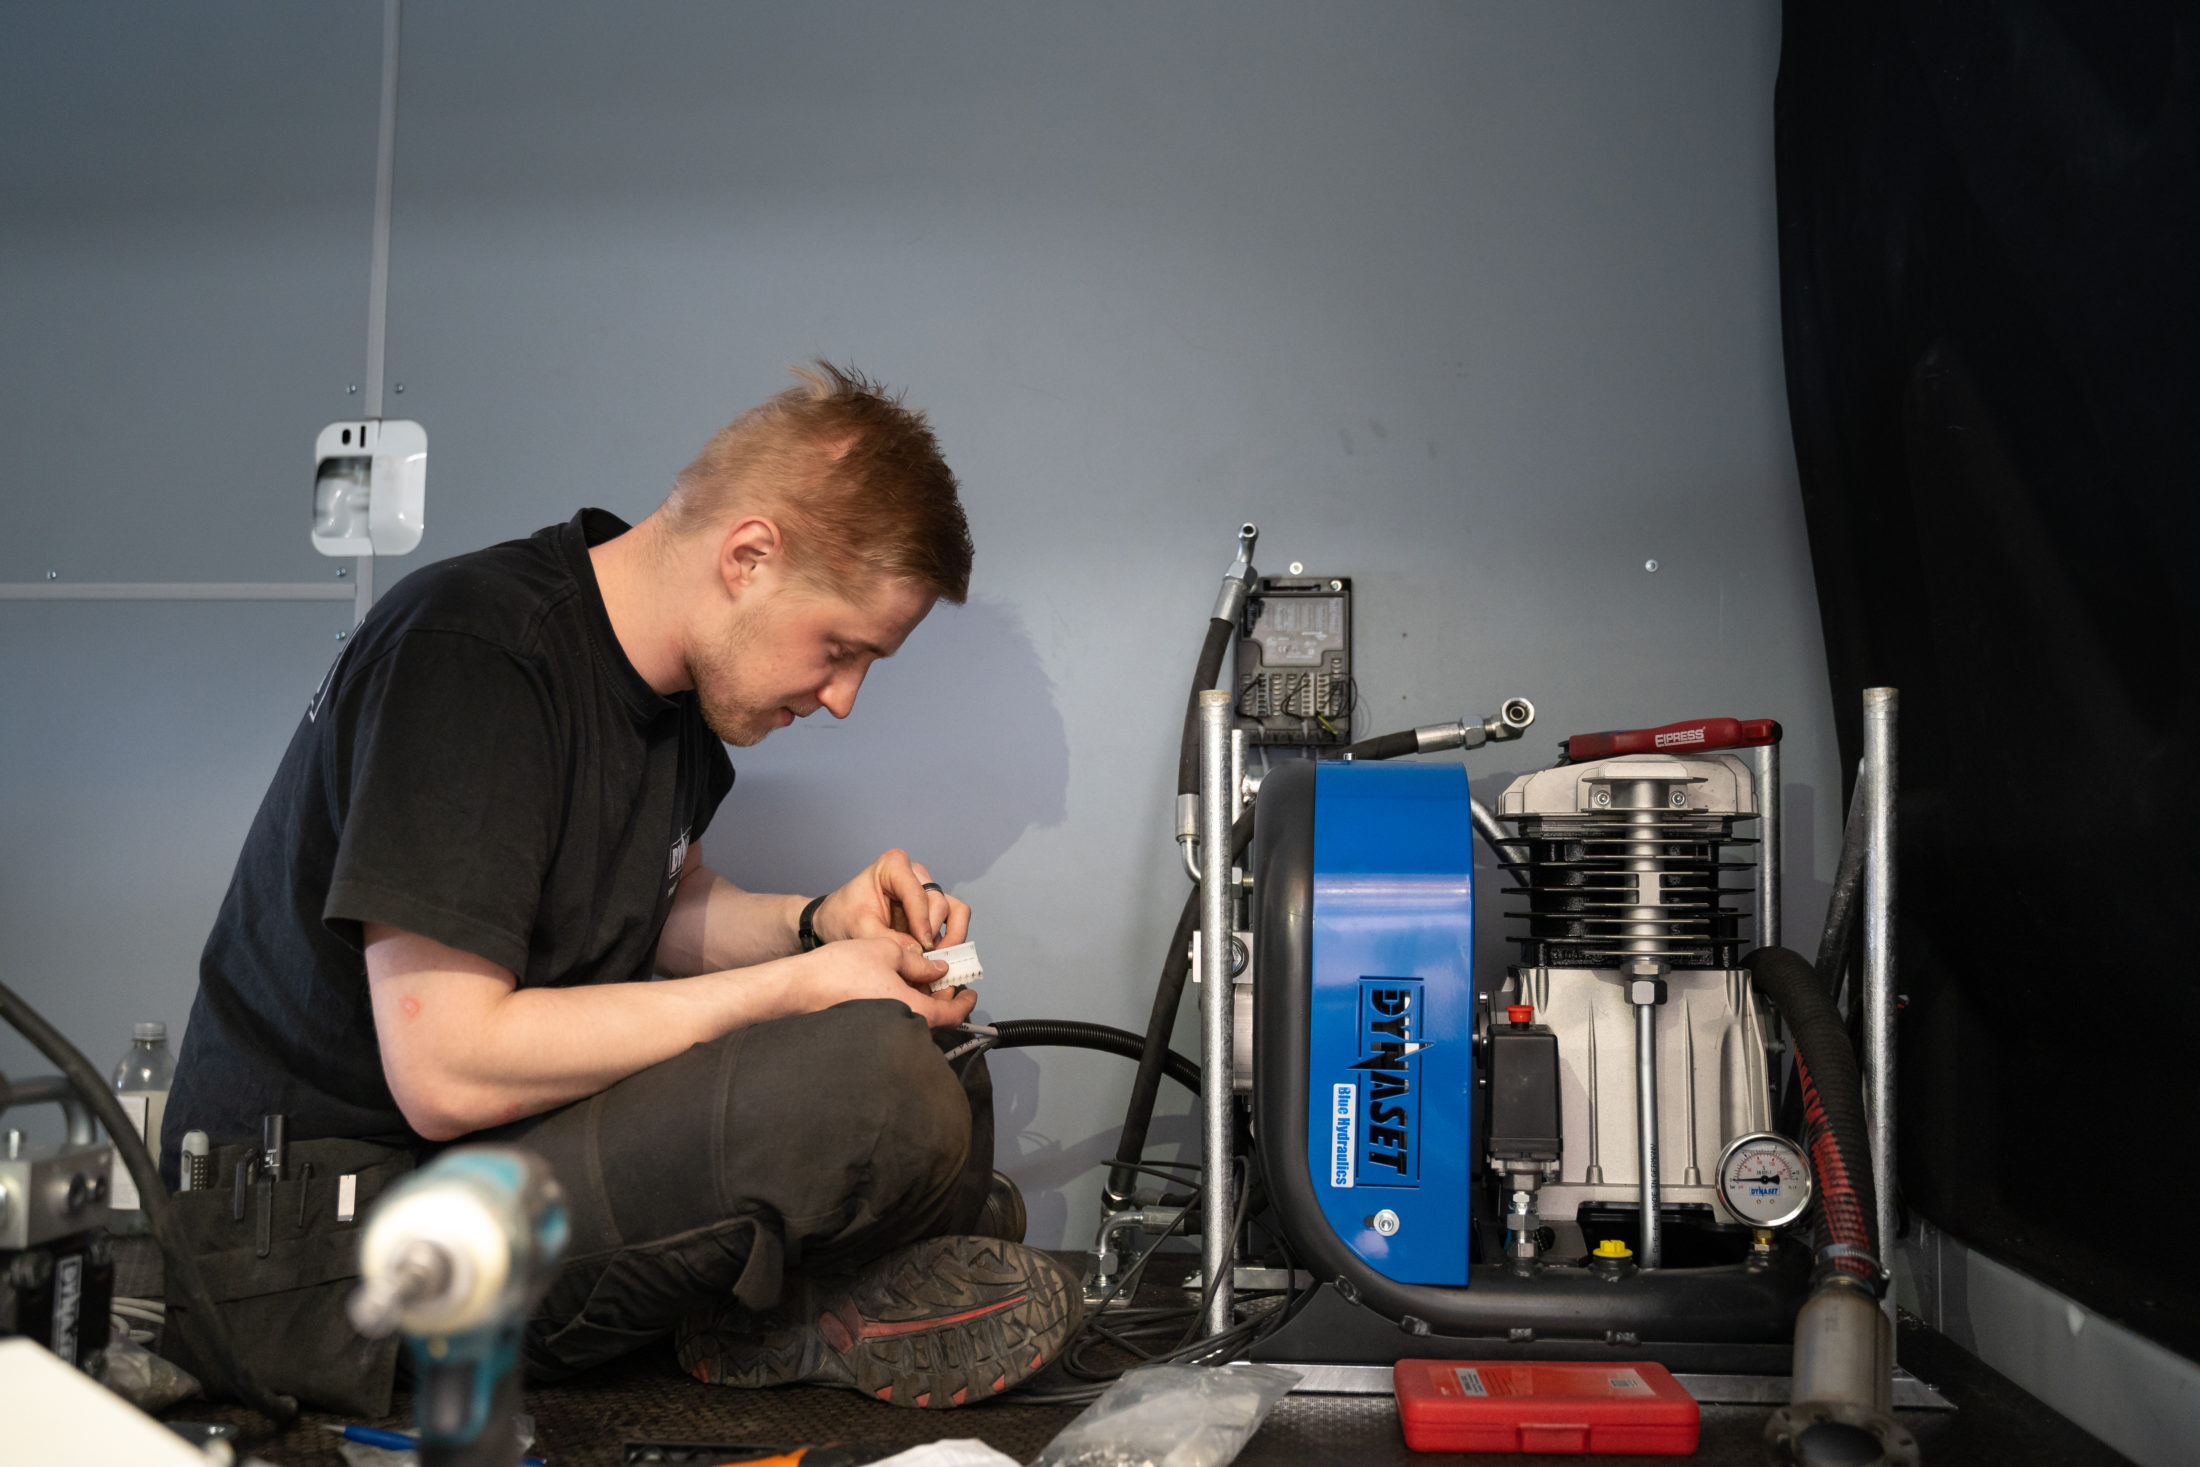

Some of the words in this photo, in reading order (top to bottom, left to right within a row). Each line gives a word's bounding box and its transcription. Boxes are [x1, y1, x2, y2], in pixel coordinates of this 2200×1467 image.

[1338, 1086, 1351, 1114] Blue
[1350, 989, 1432, 1176] DYNASET
[1335, 1116, 1351, 1186] Hydraulics
